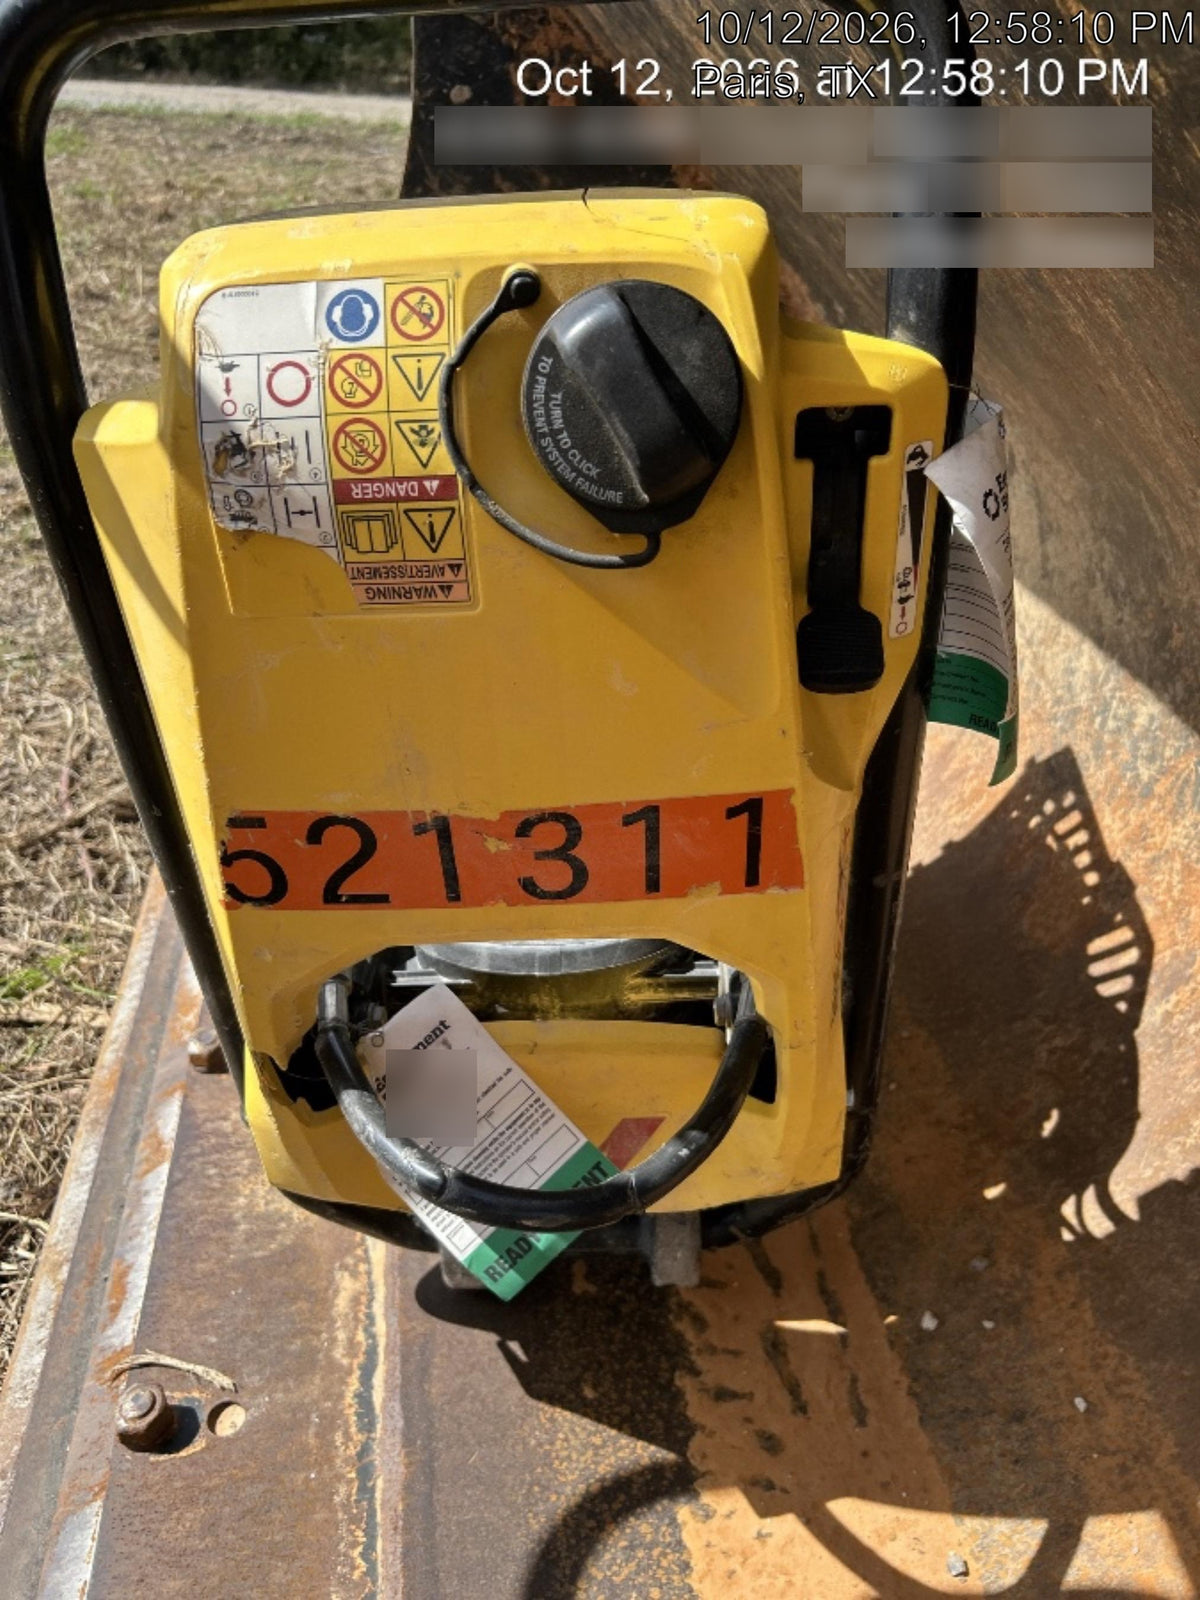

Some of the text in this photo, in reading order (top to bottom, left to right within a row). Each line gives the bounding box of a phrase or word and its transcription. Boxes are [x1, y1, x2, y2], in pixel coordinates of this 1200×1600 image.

[533, 356, 623, 503] TO PREVENT SYSTEM FAILURE
[549, 389, 601, 479] TURN TO CLICK
[350, 481, 418, 498] DANGER
[350, 563, 445, 580] AVERTISSEMENT
[364, 584, 438, 600] WARNING
